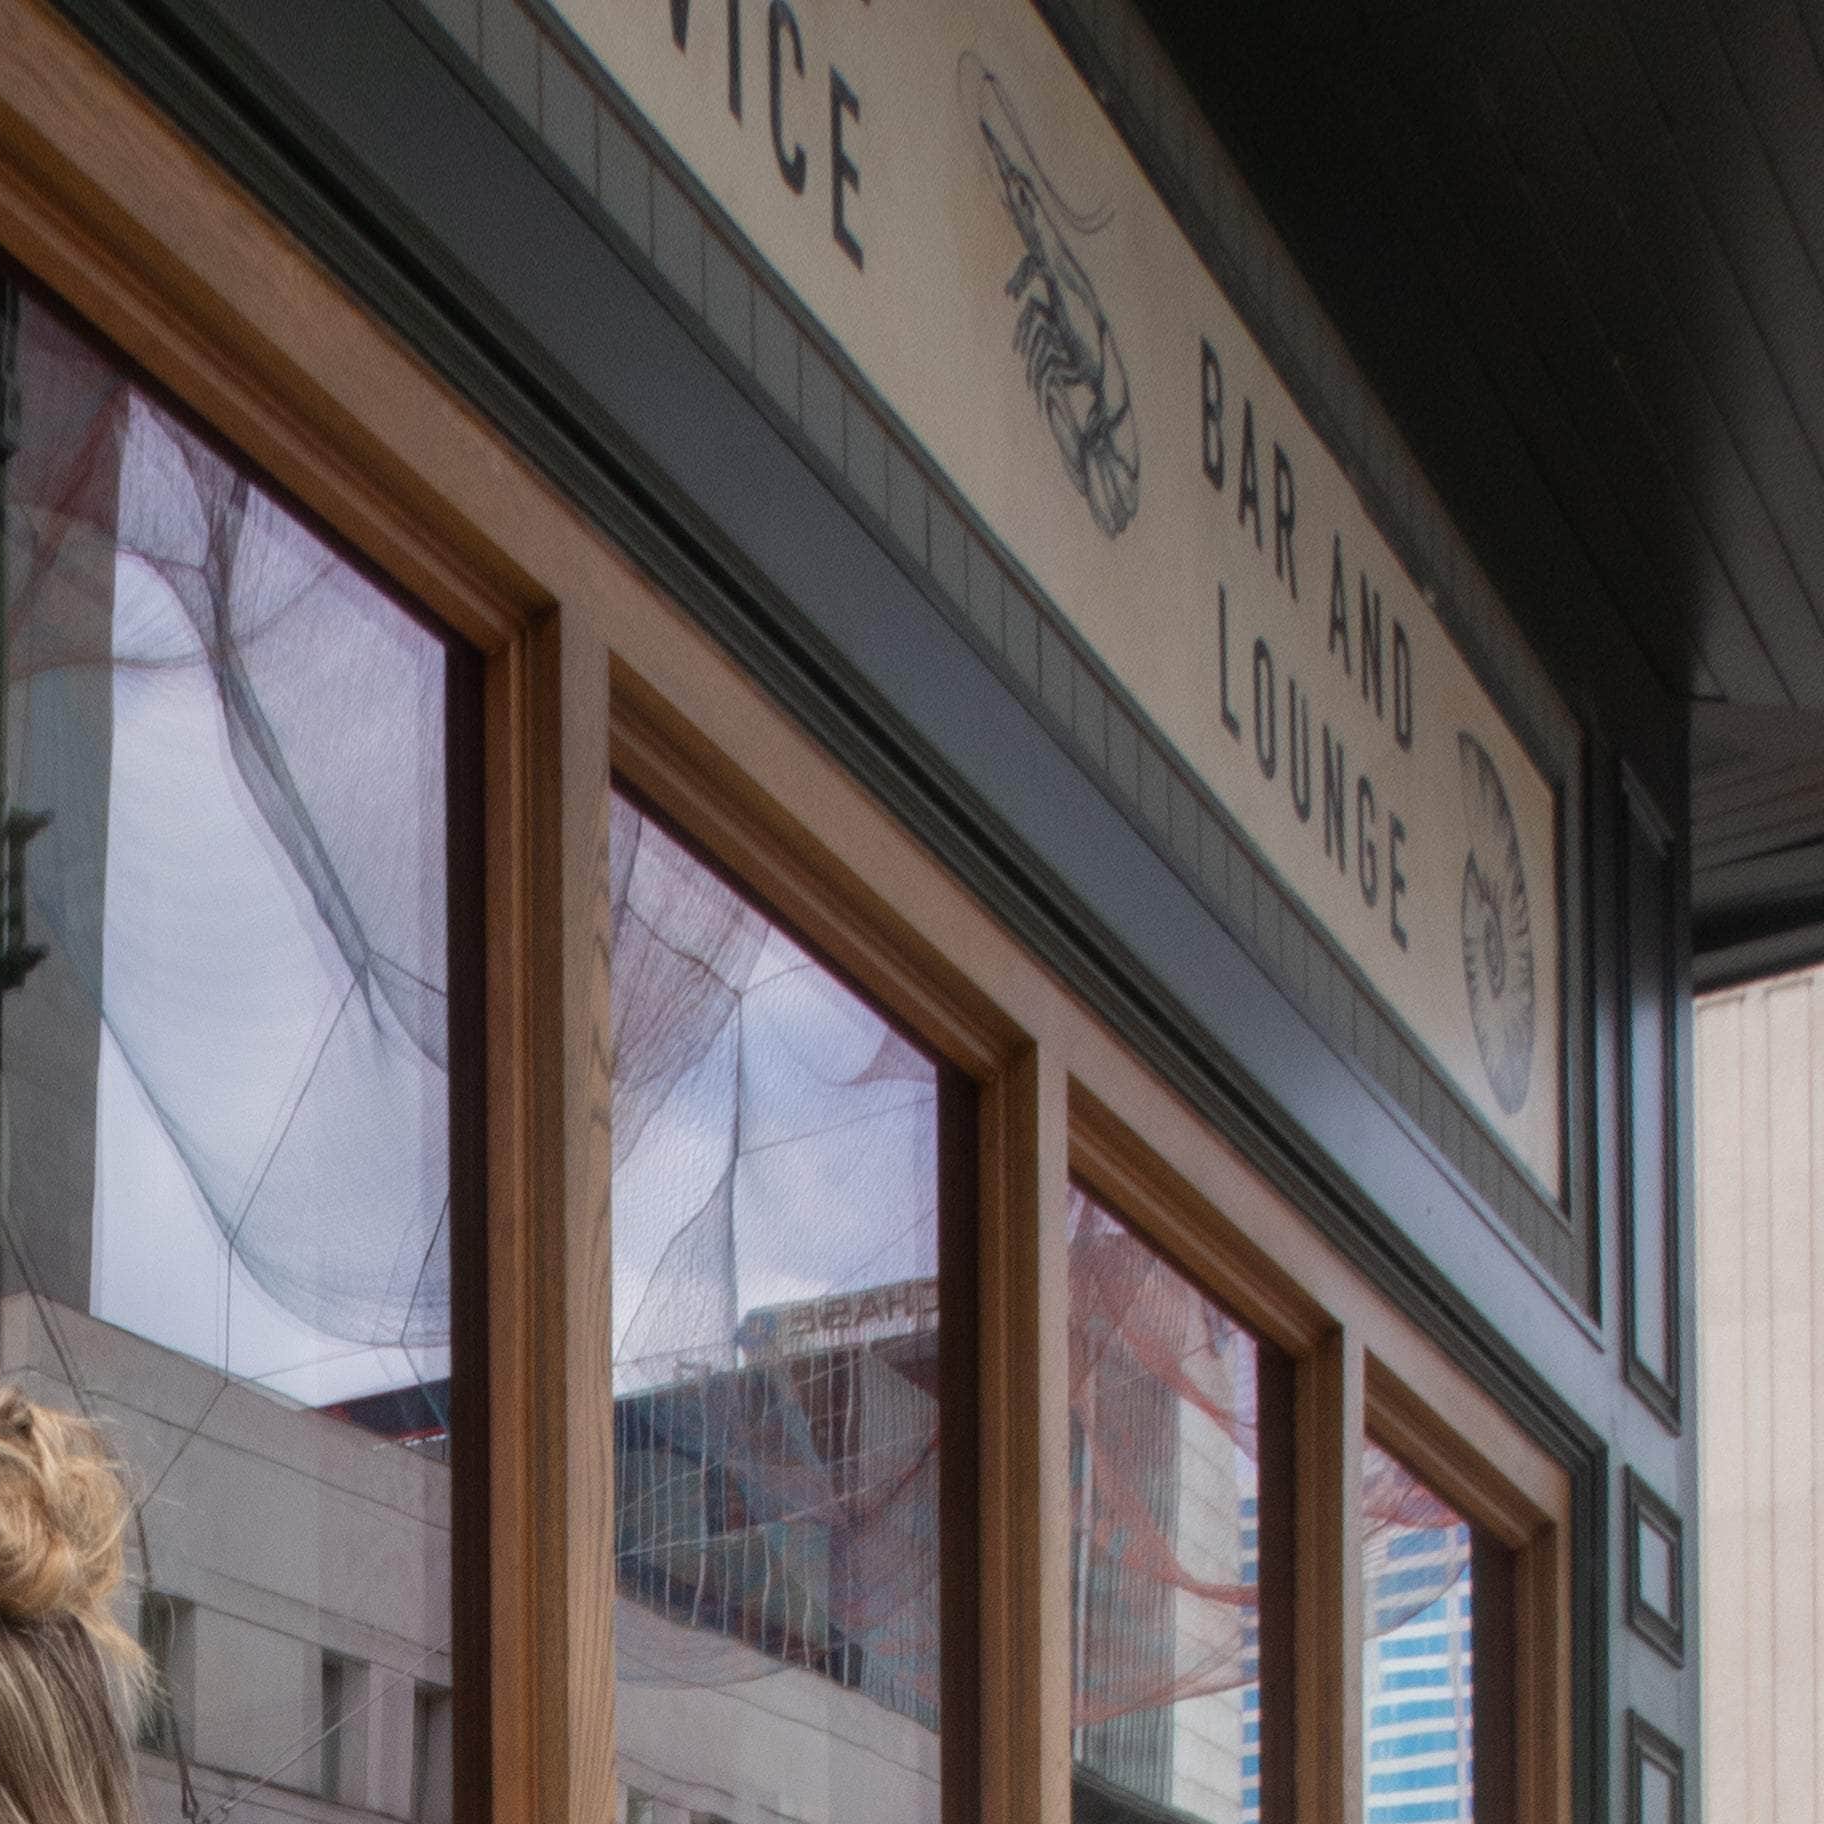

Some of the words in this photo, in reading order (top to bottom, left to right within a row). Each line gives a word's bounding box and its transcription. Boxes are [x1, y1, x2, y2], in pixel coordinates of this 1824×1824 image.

[669, 0, 865, 273] ICE
[1200, 334, 1298, 600] BAR
[1329, 530, 1413, 753] AND
[1218, 581, 1408, 952] LOUNGE
